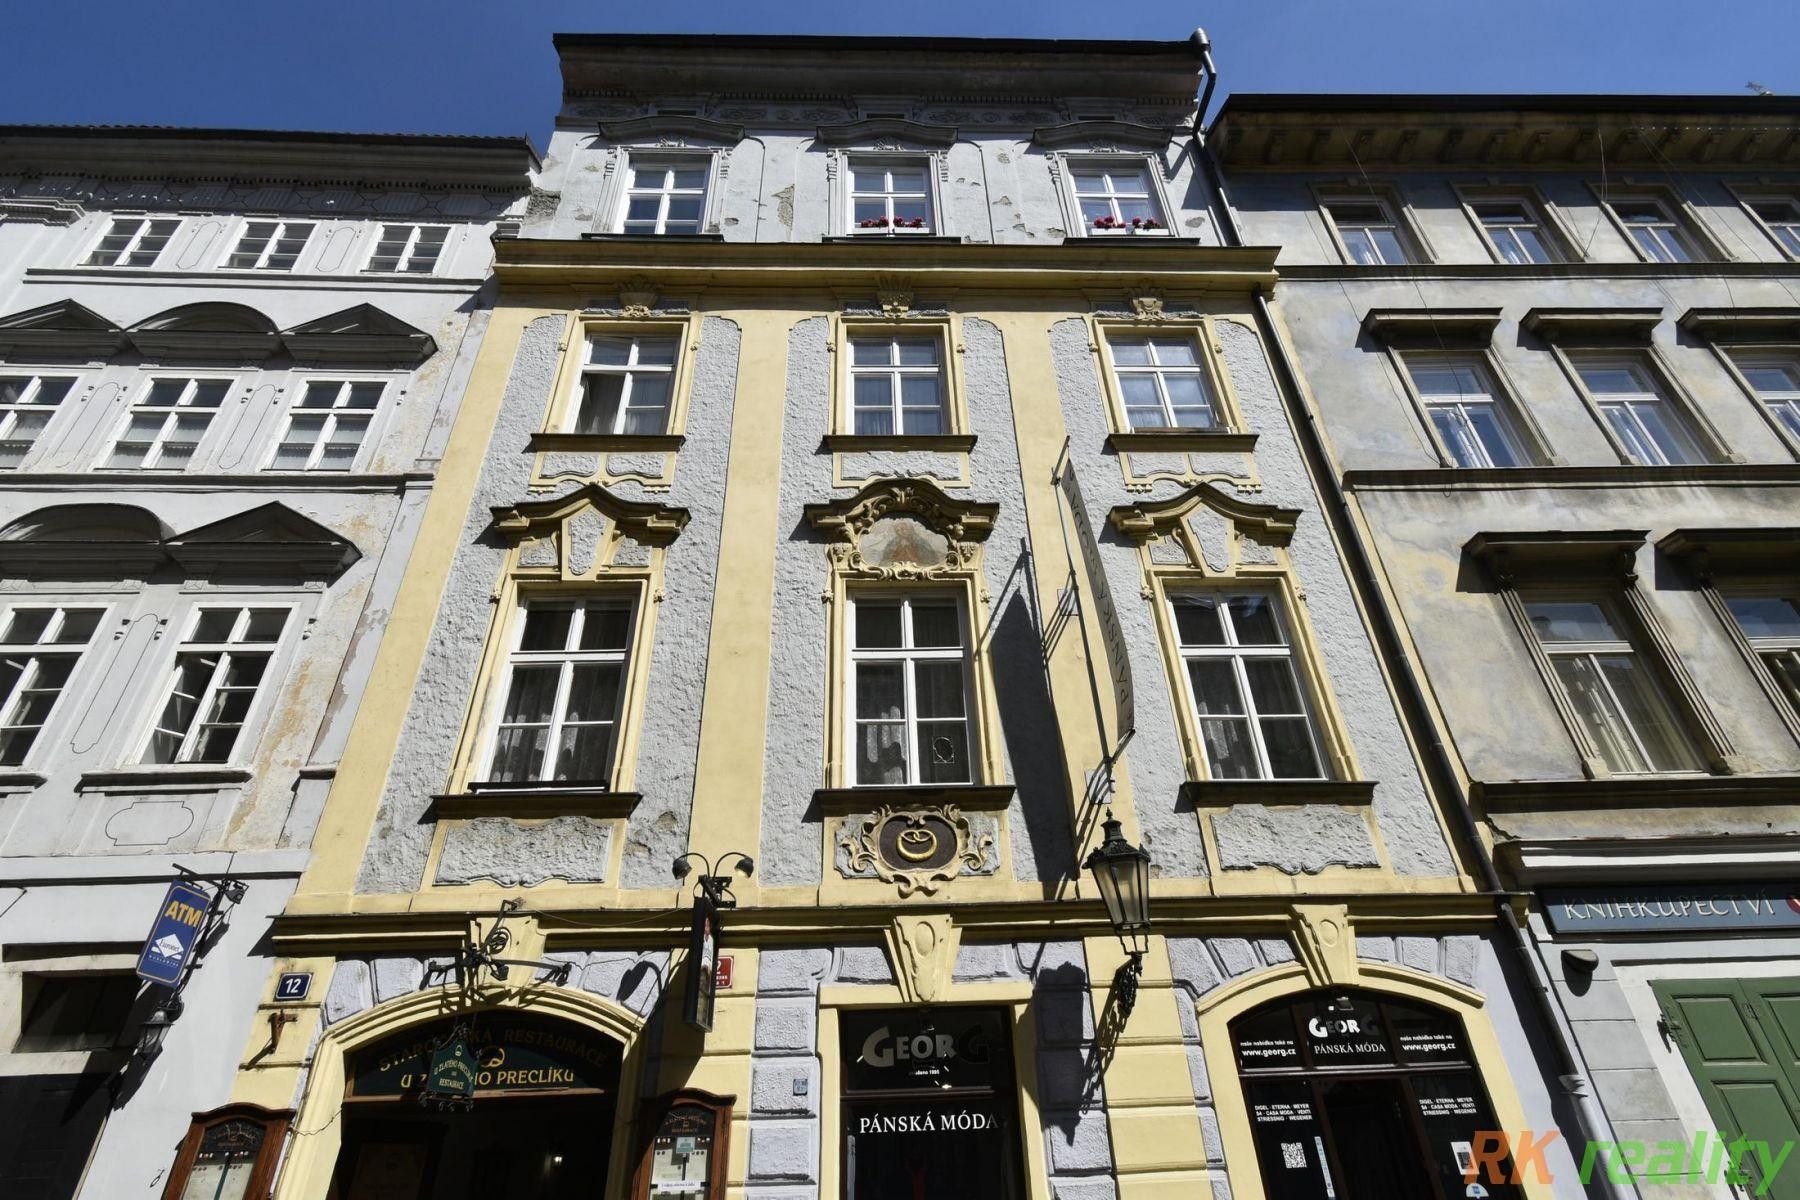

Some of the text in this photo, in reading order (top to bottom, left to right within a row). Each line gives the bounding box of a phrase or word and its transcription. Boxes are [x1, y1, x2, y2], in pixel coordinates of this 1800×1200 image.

[164, 900, 203, 928] ATM
[1561, 889, 1776, 921] KNIHKUPECTVÍ
[285, 978, 302, 994] 12
[1308, 1014, 1380, 1038] GEORG
[861, 1024, 992, 1068] GEORG
[1241, 1048, 1296, 1057] www.georg.cz
[1313, 1041, 1386, 1055] PÁNSKÁ MÓDA
[1401, 1042, 1456, 1052] www.georg.cz
[495, 1066, 576, 1086] PRECLÍKU
[859, 1109, 999, 1134] PÁNSKÁ MÓDA
